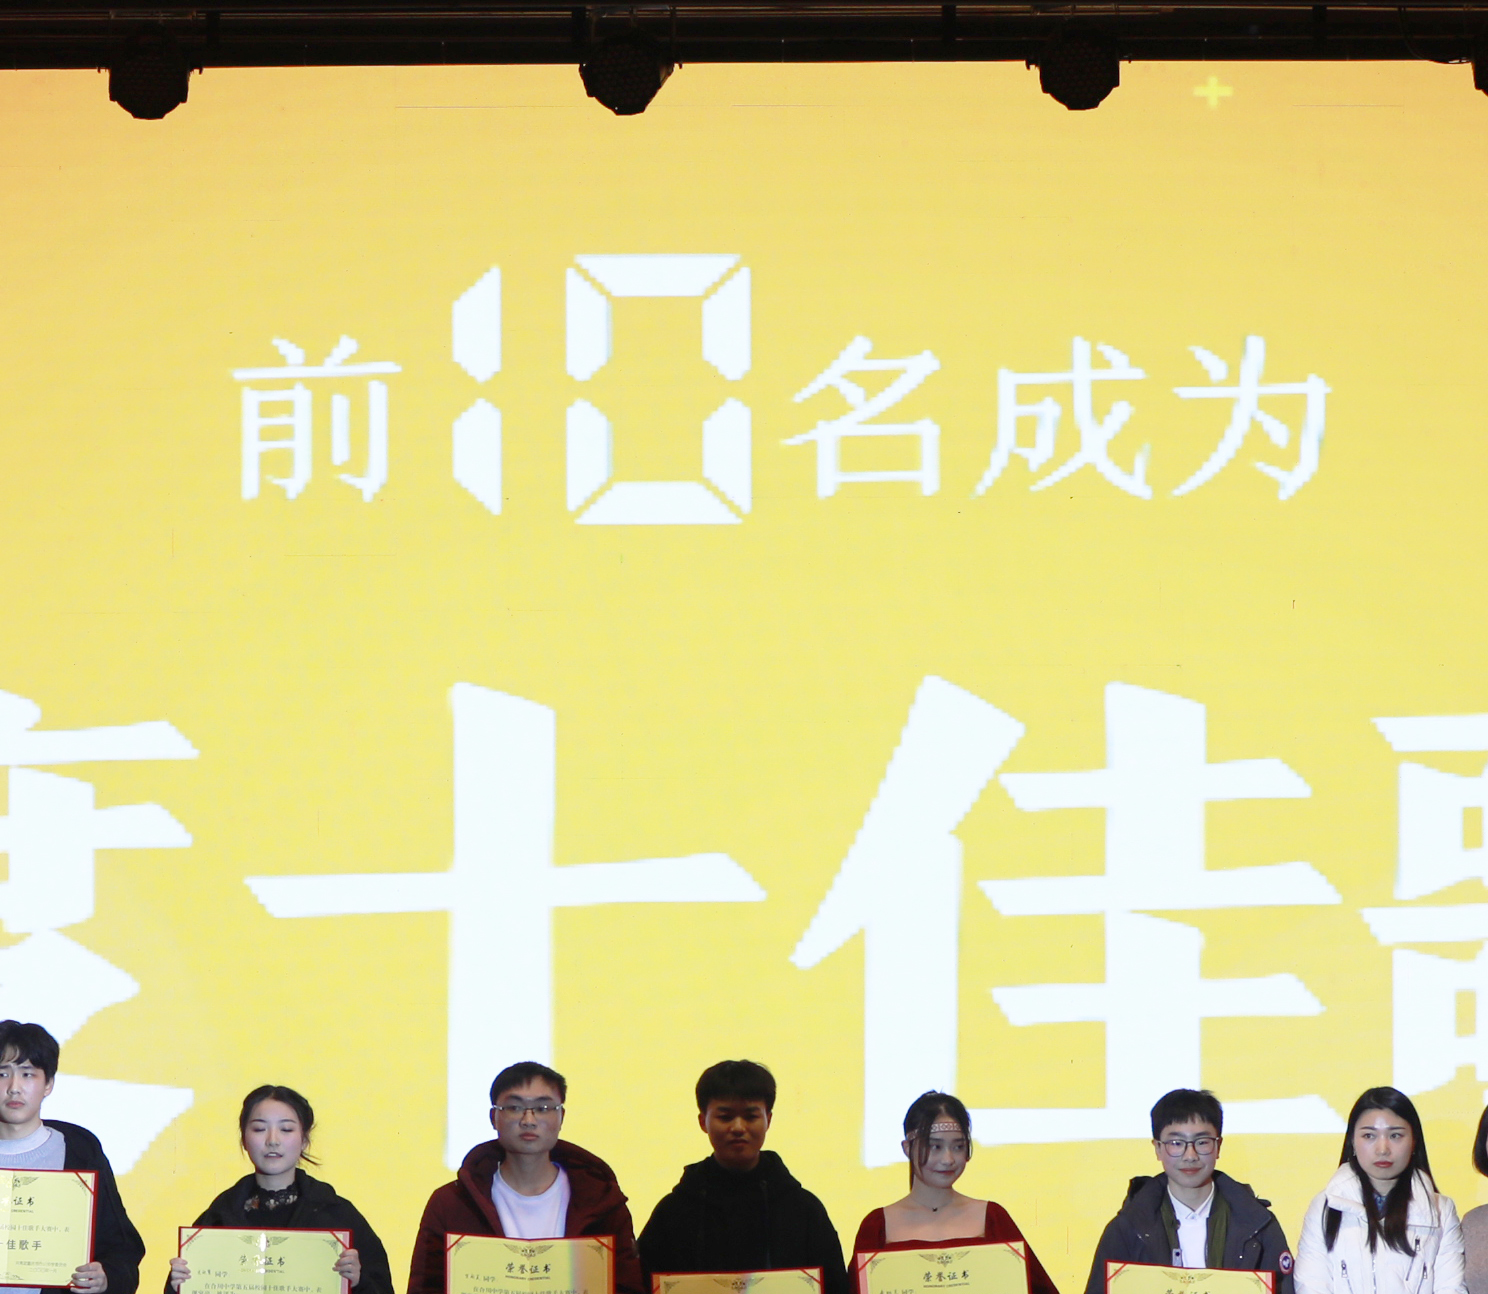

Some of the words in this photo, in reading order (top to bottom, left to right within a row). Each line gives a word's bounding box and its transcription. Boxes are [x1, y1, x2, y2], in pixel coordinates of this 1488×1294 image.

[234, 254, 1329, 524] 前10名成为
[506, 1263, 551, 1273] 荣誉证书
[923, 1270, 970, 1282] 荣誉证书
